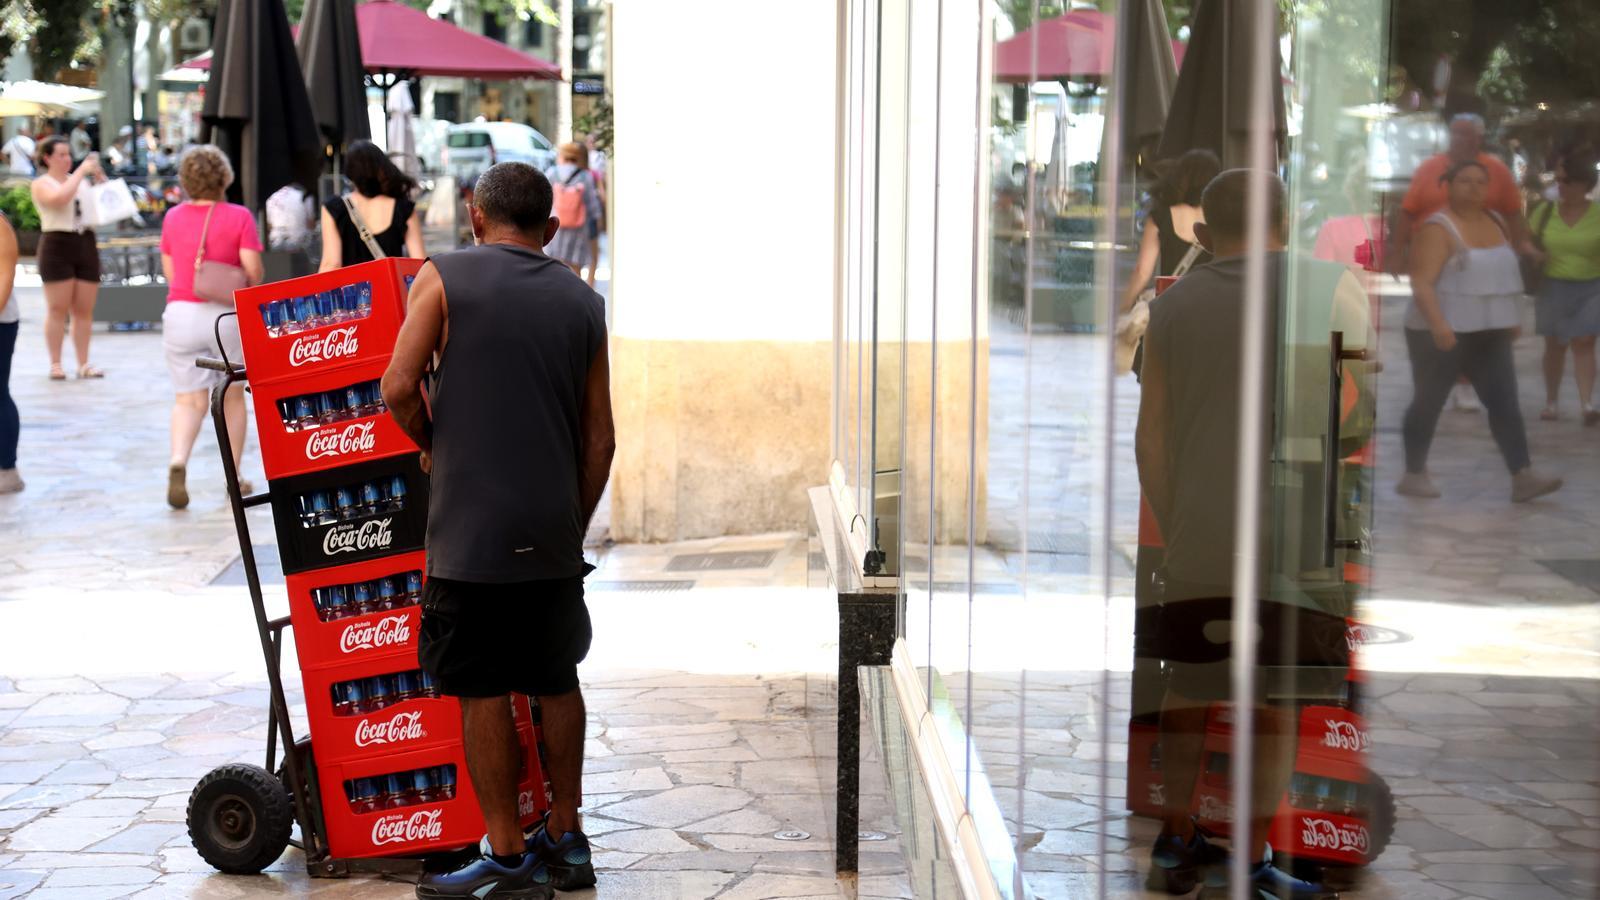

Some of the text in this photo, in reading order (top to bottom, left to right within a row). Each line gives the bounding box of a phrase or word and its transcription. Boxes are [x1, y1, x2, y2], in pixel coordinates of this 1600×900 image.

[289, 324, 359, 367] Coca-Cola
[305, 419, 376, 461] Coca-Cola
[323, 516, 393, 556] Coca-Cola
[340, 613, 410, 654] Coca-Cola
[354, 710, 423, 747] Coca-Cola
[371, 808, 443, 846] Coca-Cola
